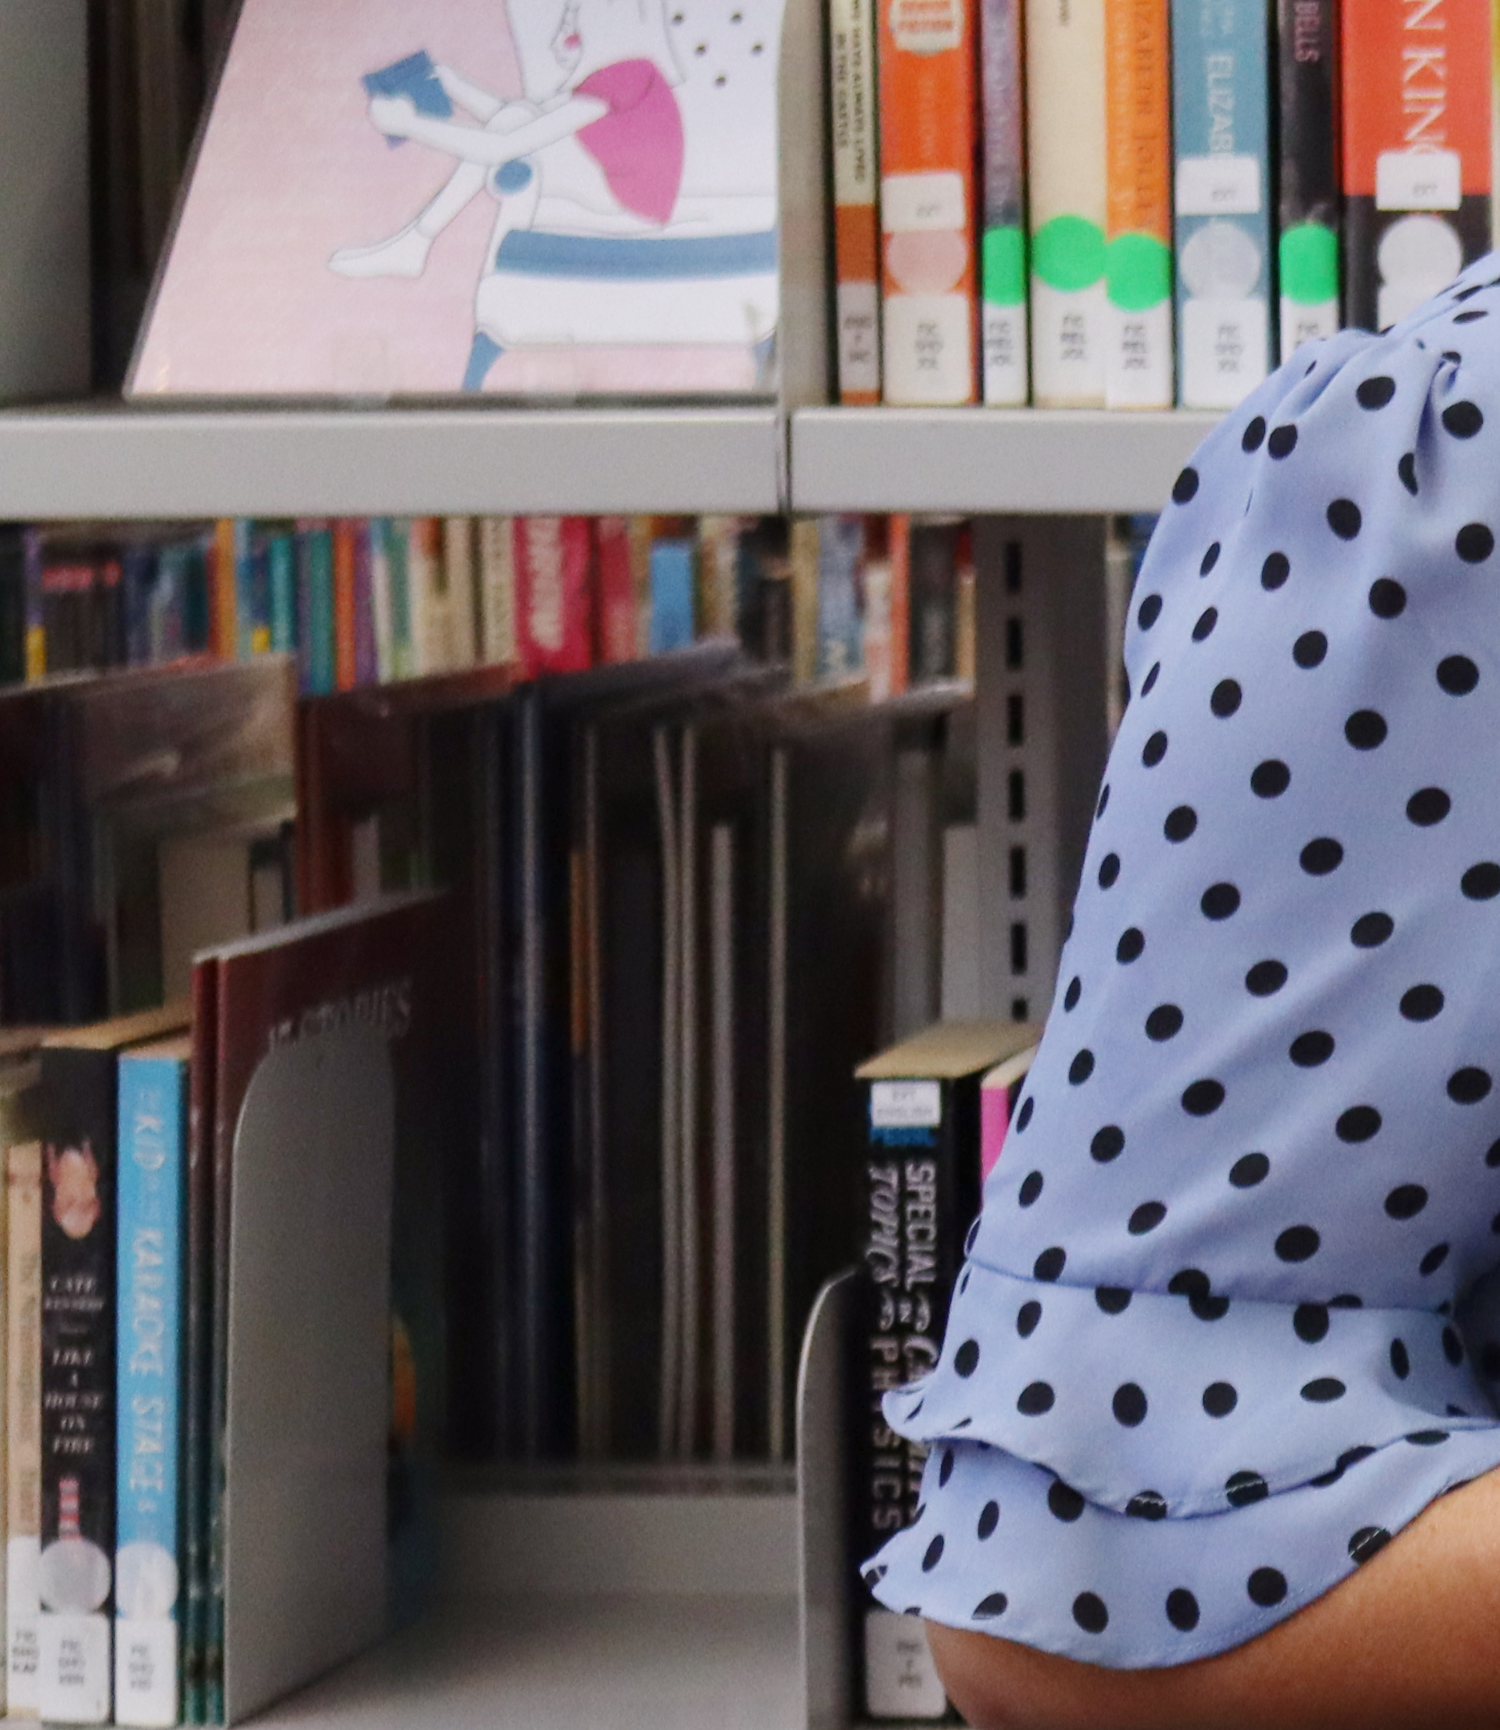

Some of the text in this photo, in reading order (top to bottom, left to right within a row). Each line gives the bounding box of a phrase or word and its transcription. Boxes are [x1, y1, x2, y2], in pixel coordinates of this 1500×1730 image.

[1205, 53, 1237, 155] ELIZAB
[132, 1112, 166, 1171] KID
[865, 1162, 902, 1287] TOPICS
[902, 1161, 939, 1291] SPECIAL
[131, 1226, 165, 1378] KARAOKE
[870, 1336, 904, 1531] PHSICS
